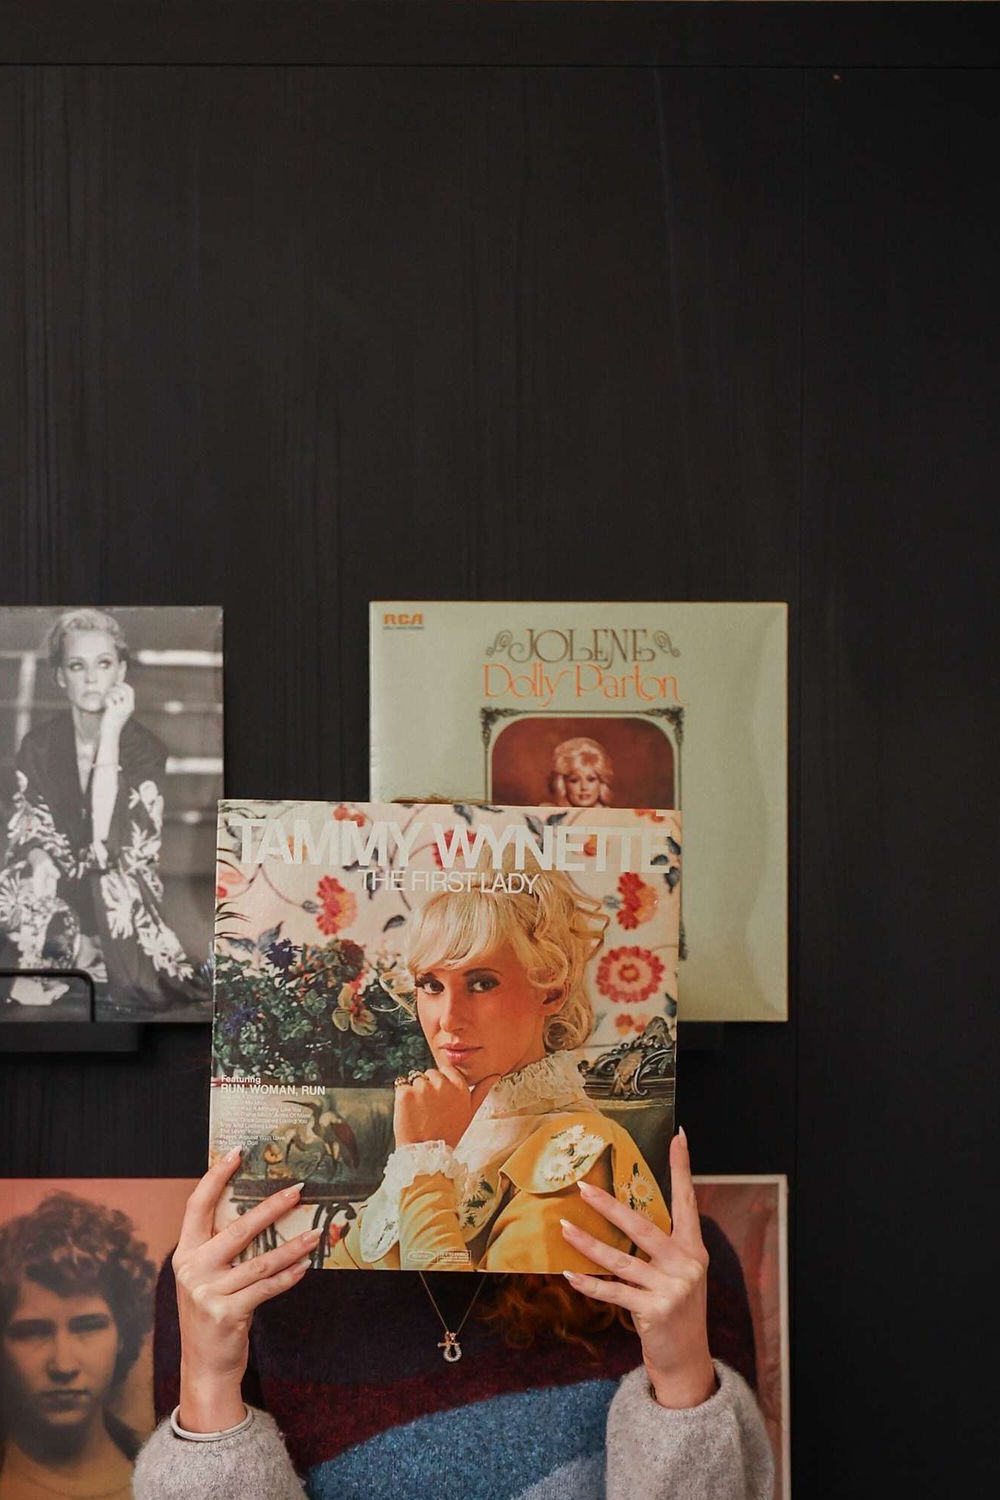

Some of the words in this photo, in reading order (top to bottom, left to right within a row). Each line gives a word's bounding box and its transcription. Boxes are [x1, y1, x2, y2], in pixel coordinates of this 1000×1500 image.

[383, 613, 424, 625] RCA
[507, 628, 656, 669] JOLENE
[483, 661, 572, 707] Dolly
[576, 661, 690, 706] Parton
[228, 818, 424, 868] TAMMY
[431, 821, 671, 873] WYNETTE
[358, 869, 406, 890] THE
[411, 870, 477, 893] FIRST
[481, 872, 541, 895] LADY
[221, 1074, 261, 1084] Featuring
[249, 1085, 298, 1097] WOMAN,
[302, 1085, 326, 1096] RUN
